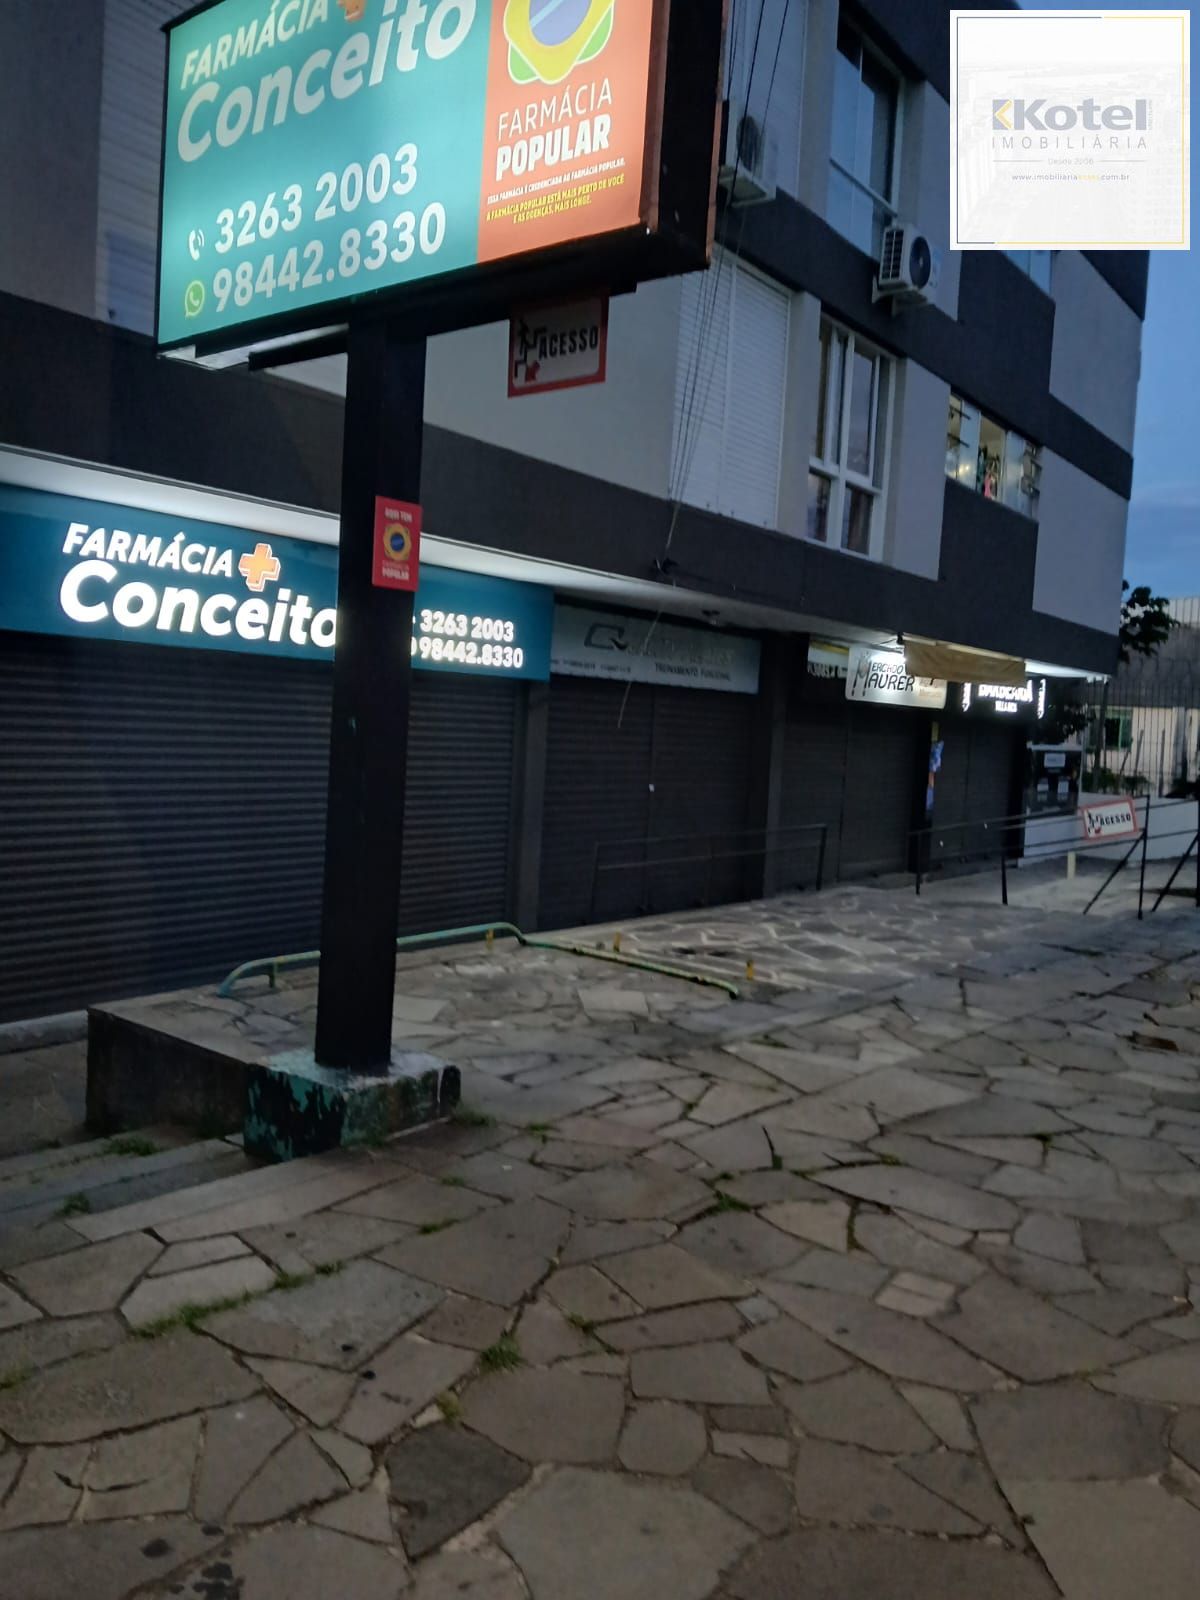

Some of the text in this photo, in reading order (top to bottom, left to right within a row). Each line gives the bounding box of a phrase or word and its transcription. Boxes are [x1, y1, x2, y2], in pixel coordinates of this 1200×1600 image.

[180, 0, 328, 91] FARMÁCIA
[177, 0, 476, 163] Conceito
[498, 78, 613, 141] FARMÁCIA
[496, 113, 611, 181] POPULAR
[571, 164, 598, 180] FARMÁCIA
[214, 142, 418, 254] 3263 2003
[491, 205, 520, 219] FARMÁCIA
[519, 196, 546, 214] POPULAR
[546, 191, 561, 205] ESTÁ
[562, 187, 577, 201] MAIS
[578, 182, 598, 196] PERTO
[555, 201, 570, 214] MAIS
[211, 202, 447, 313] 98442.8330
[538, 325, 599, 361] ACESSO
[62, 522, 233, 578] FARMÁCIA
[59, 559, 337, 649] Conceito
[420, 609, 514, 642] 3263 2003
[418, 636, 524, 669] 98442.8330
